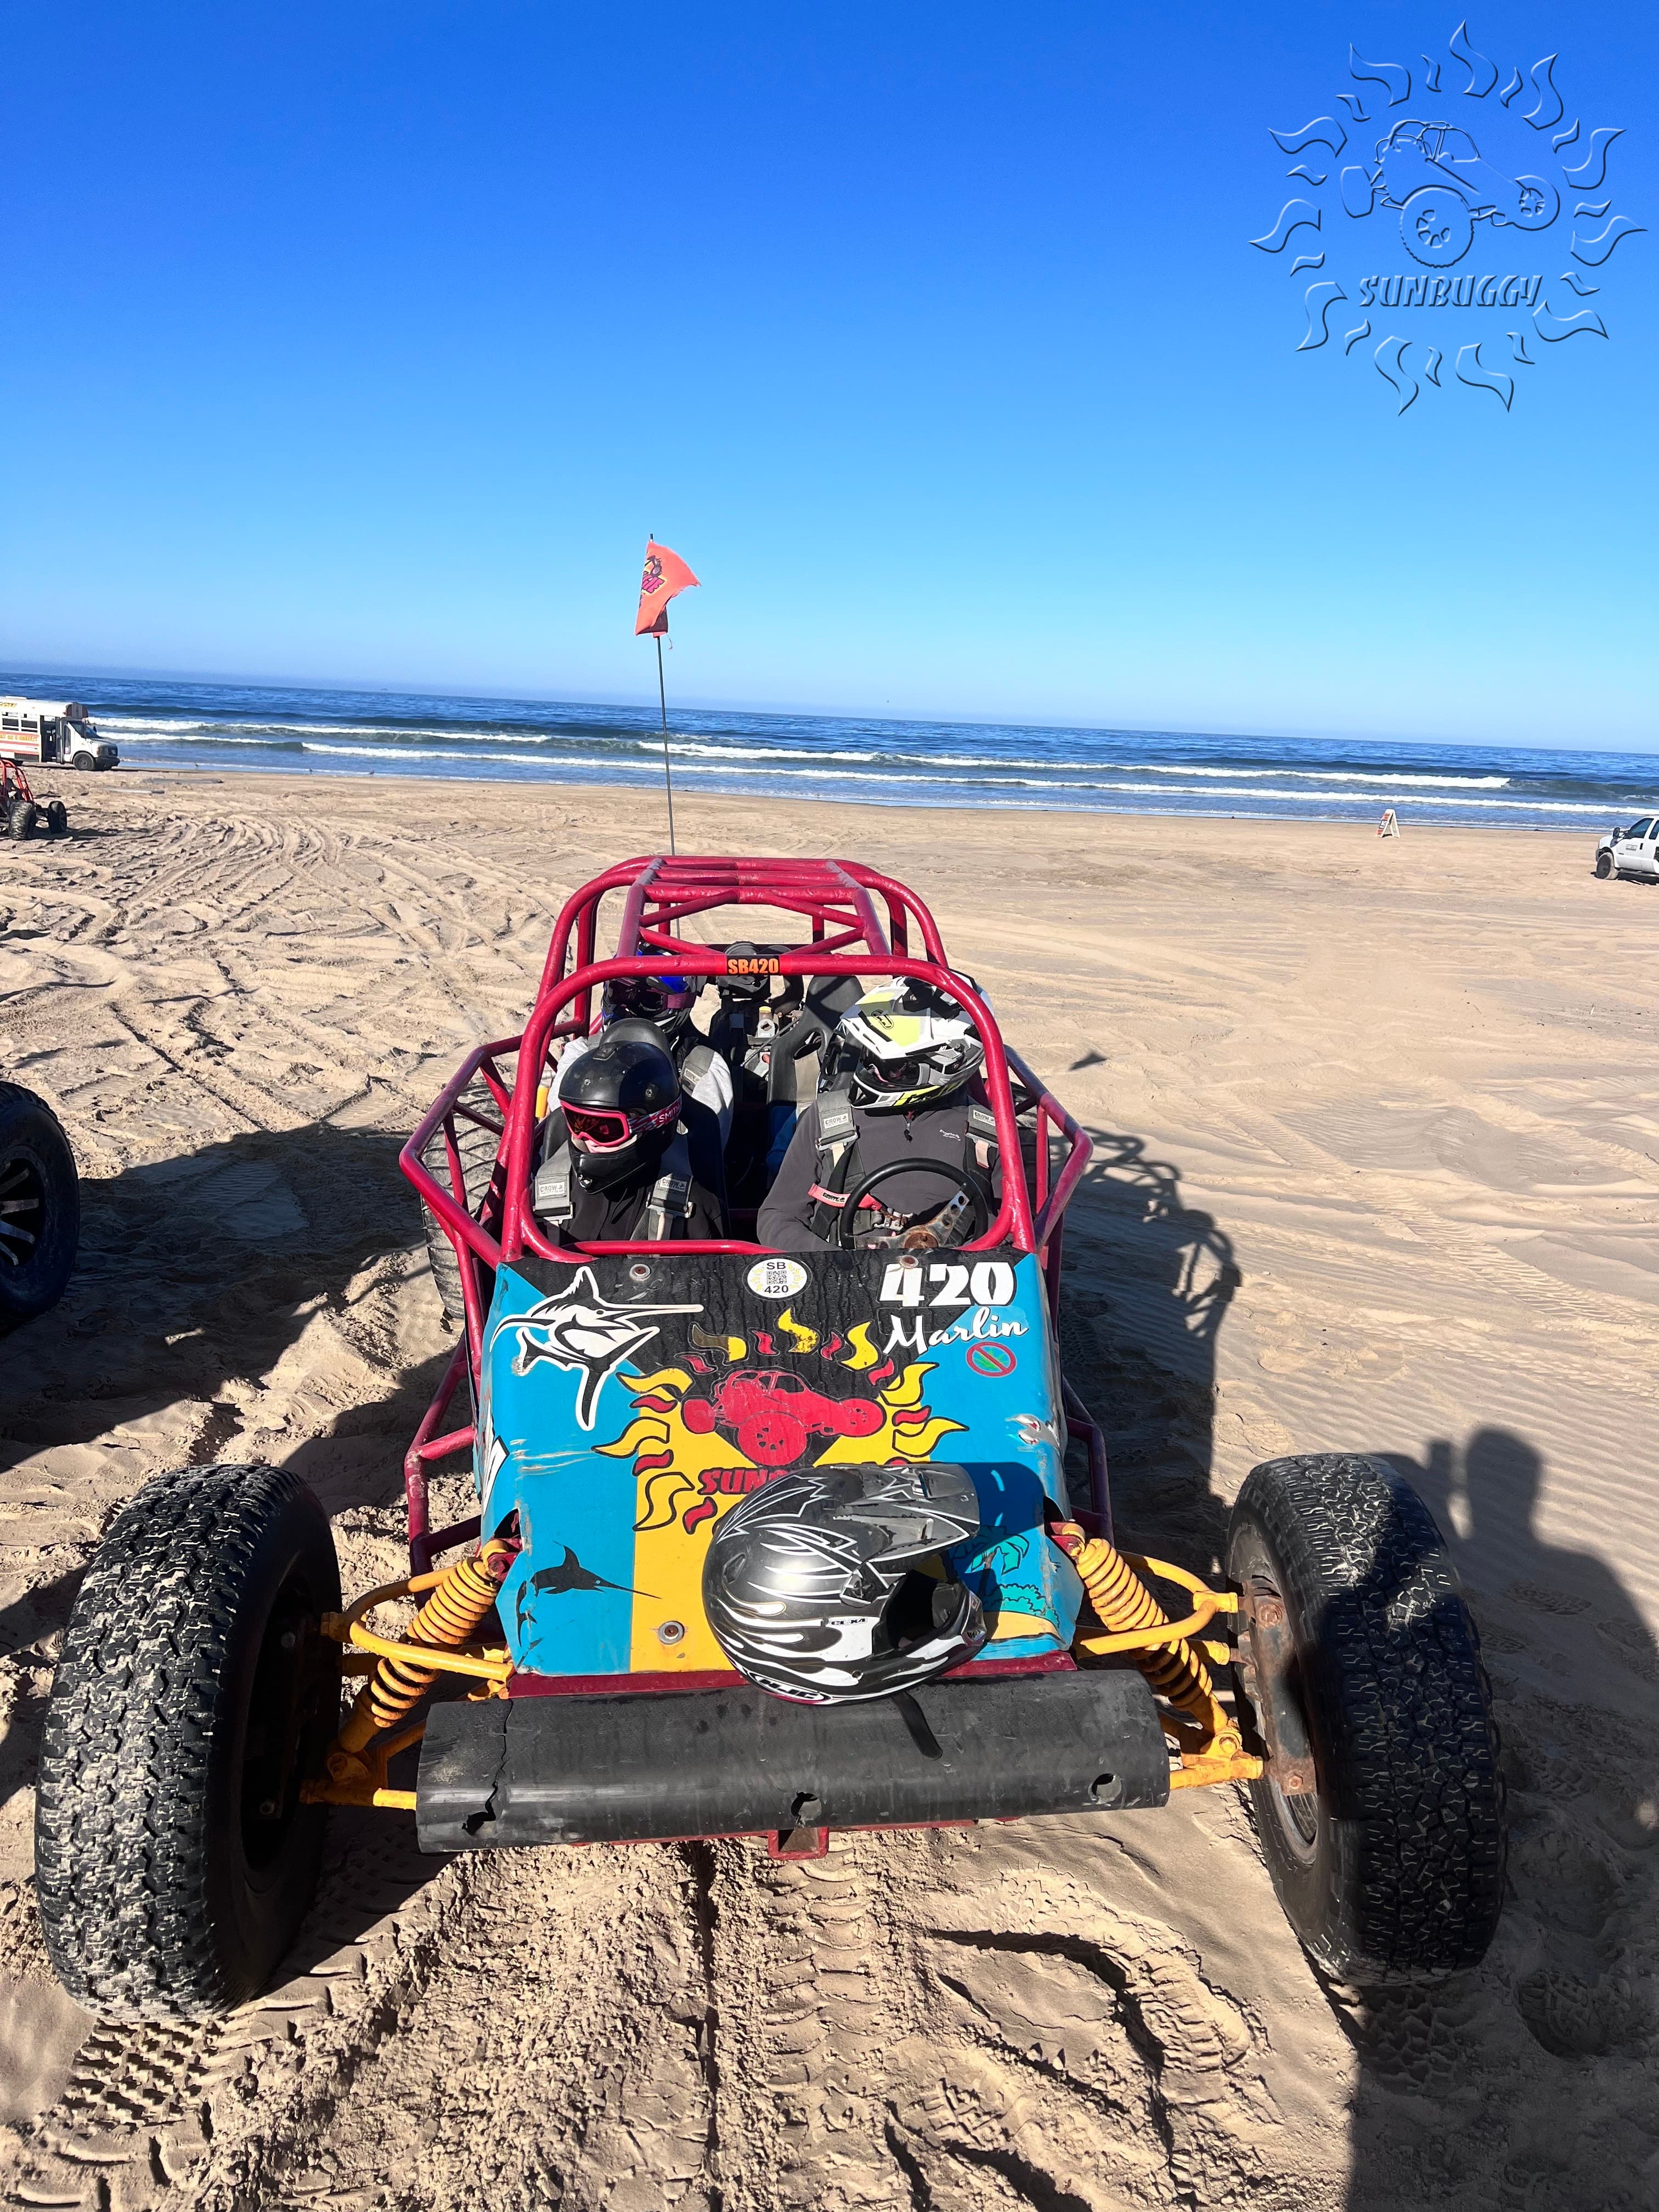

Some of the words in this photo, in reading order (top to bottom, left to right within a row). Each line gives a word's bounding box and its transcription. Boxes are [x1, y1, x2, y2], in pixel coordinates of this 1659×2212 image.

[727, 958, 779, 974] SB420
[826, 1116, 841, 1125] CROW
[764, 1285, 789, 1294] 420
[879, 1262, 1014, 1307] 420
[883, 1306, 1028, 1355] Marlin
